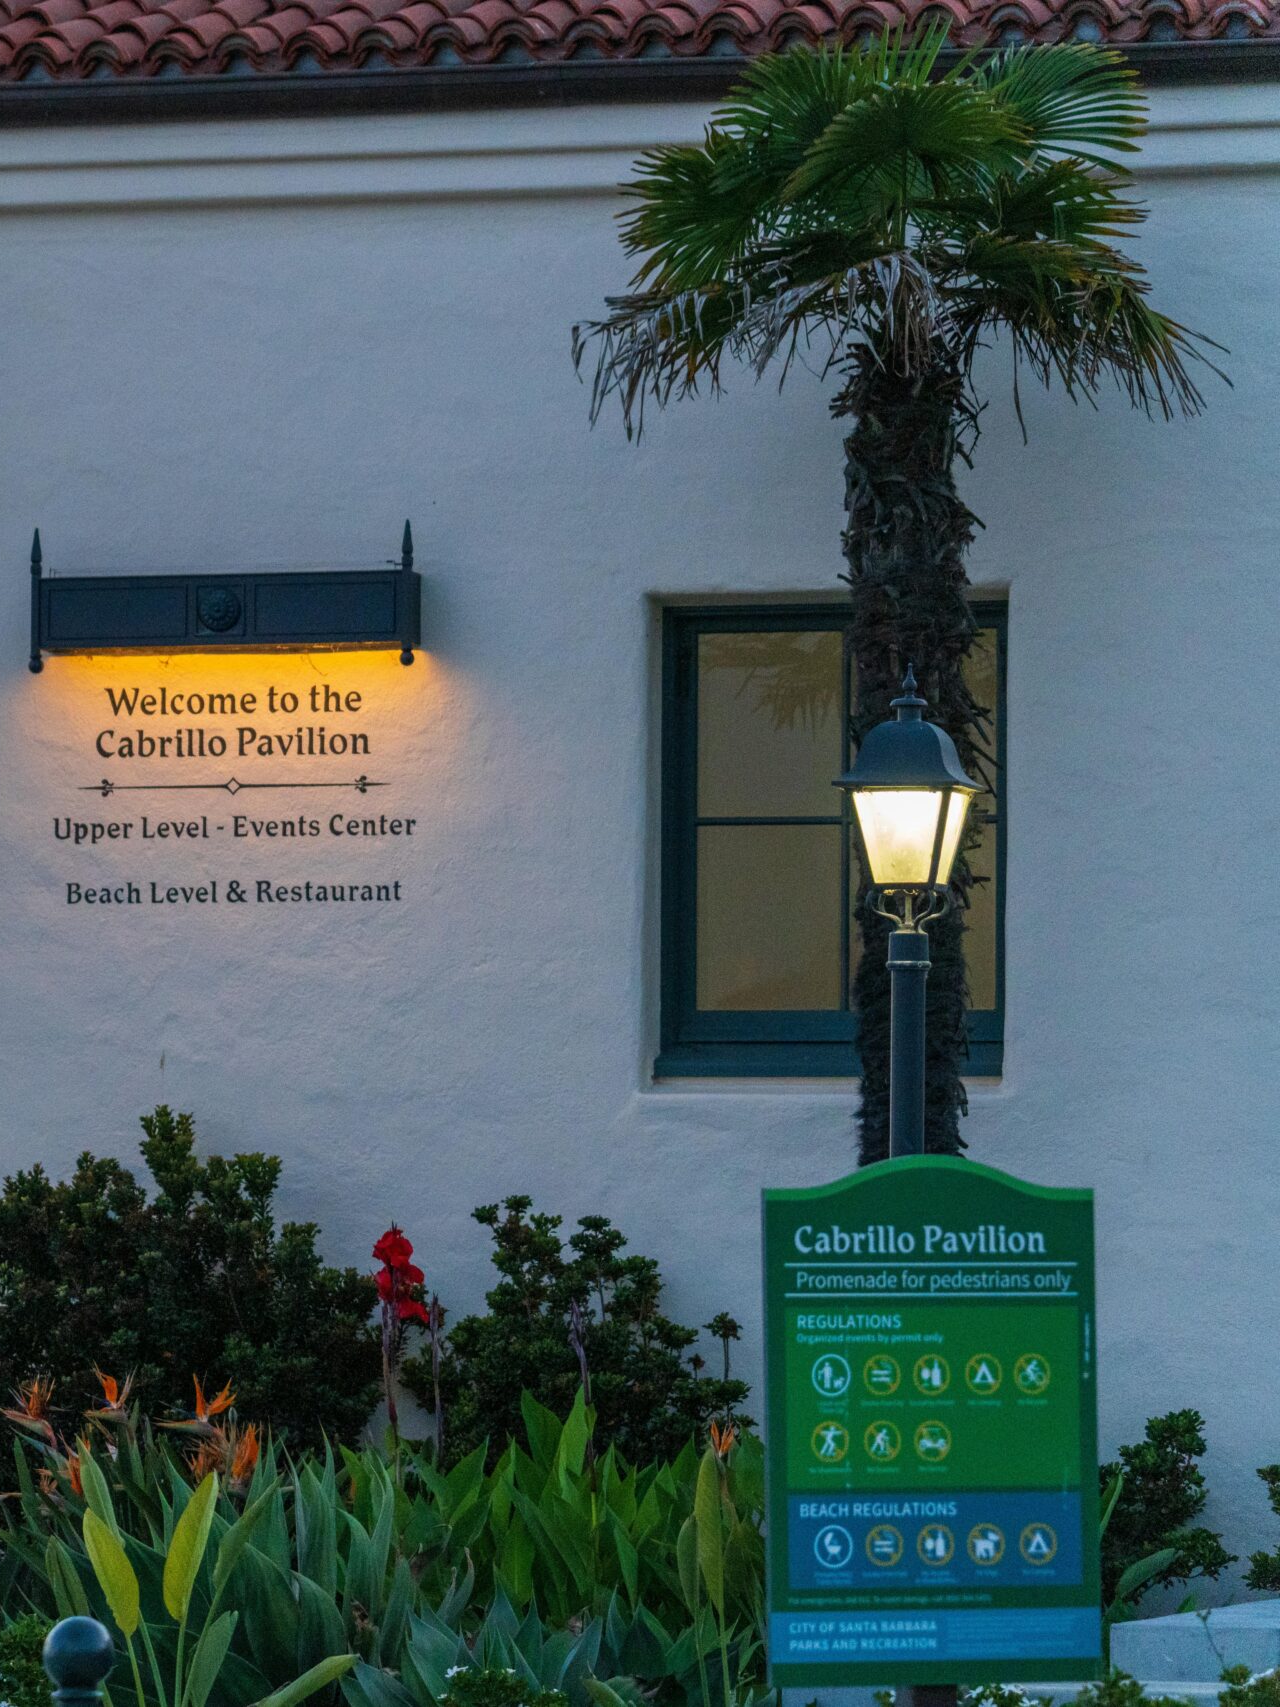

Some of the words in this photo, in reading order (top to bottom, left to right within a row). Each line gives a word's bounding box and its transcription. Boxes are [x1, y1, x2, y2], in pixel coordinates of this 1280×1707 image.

[104, 687, 257, 716] Welcome
[267, 685, 299, 713] to
[309, 684, 363, 713] the
[95, 728, 228, 758] Cabrillo
[237, 726, 372, 757] Pavilion
[53, 817, 133, 844] Upper
[141, 816, 210, 840] Level
[233, 815, 320, 838] Events
[329, 813, 417, 837] Center
[66, 882, 141, 904] Beach
[150, 881, 218, 904] Level
[225, 880, 247, 903] &
[256, 879, 402, 903] Restaurant
[794, 1225, 916, 1254] Cabrillo
[923, 1224, 1046, 1254] Pavilion
[796, 1271, 898, 1289] Promenade
[901, 1270, 926, 1288] for
[930, 1270, 1031, 1292] pedestrians
[1033, 1269, 1071, 1292] only
[796, 1314, 902, 1329] REGULATIONS
[796, 1333, 844, 1344] Organized
[877, 1333, 889, 1344] by
[890, 1333, 921, 1344] permit
[922, 1332, 944, 1344] only
[799, 1502, 849, 1518] BEACH
[852, 1501, 958, 1517] REGULATIONS
[788, 1621, 816, 1634] CITY
[819, 1621, 836, 1634] OF
[838, 1620, 878, 1633] SANTA
[880, 1619, 938, 1632] BARBARA
[789, 1639, 829, 1651] PARKS
[831, 1639, 858, 1651] AND
[860, 1637, 938, 1650] RECREATION
